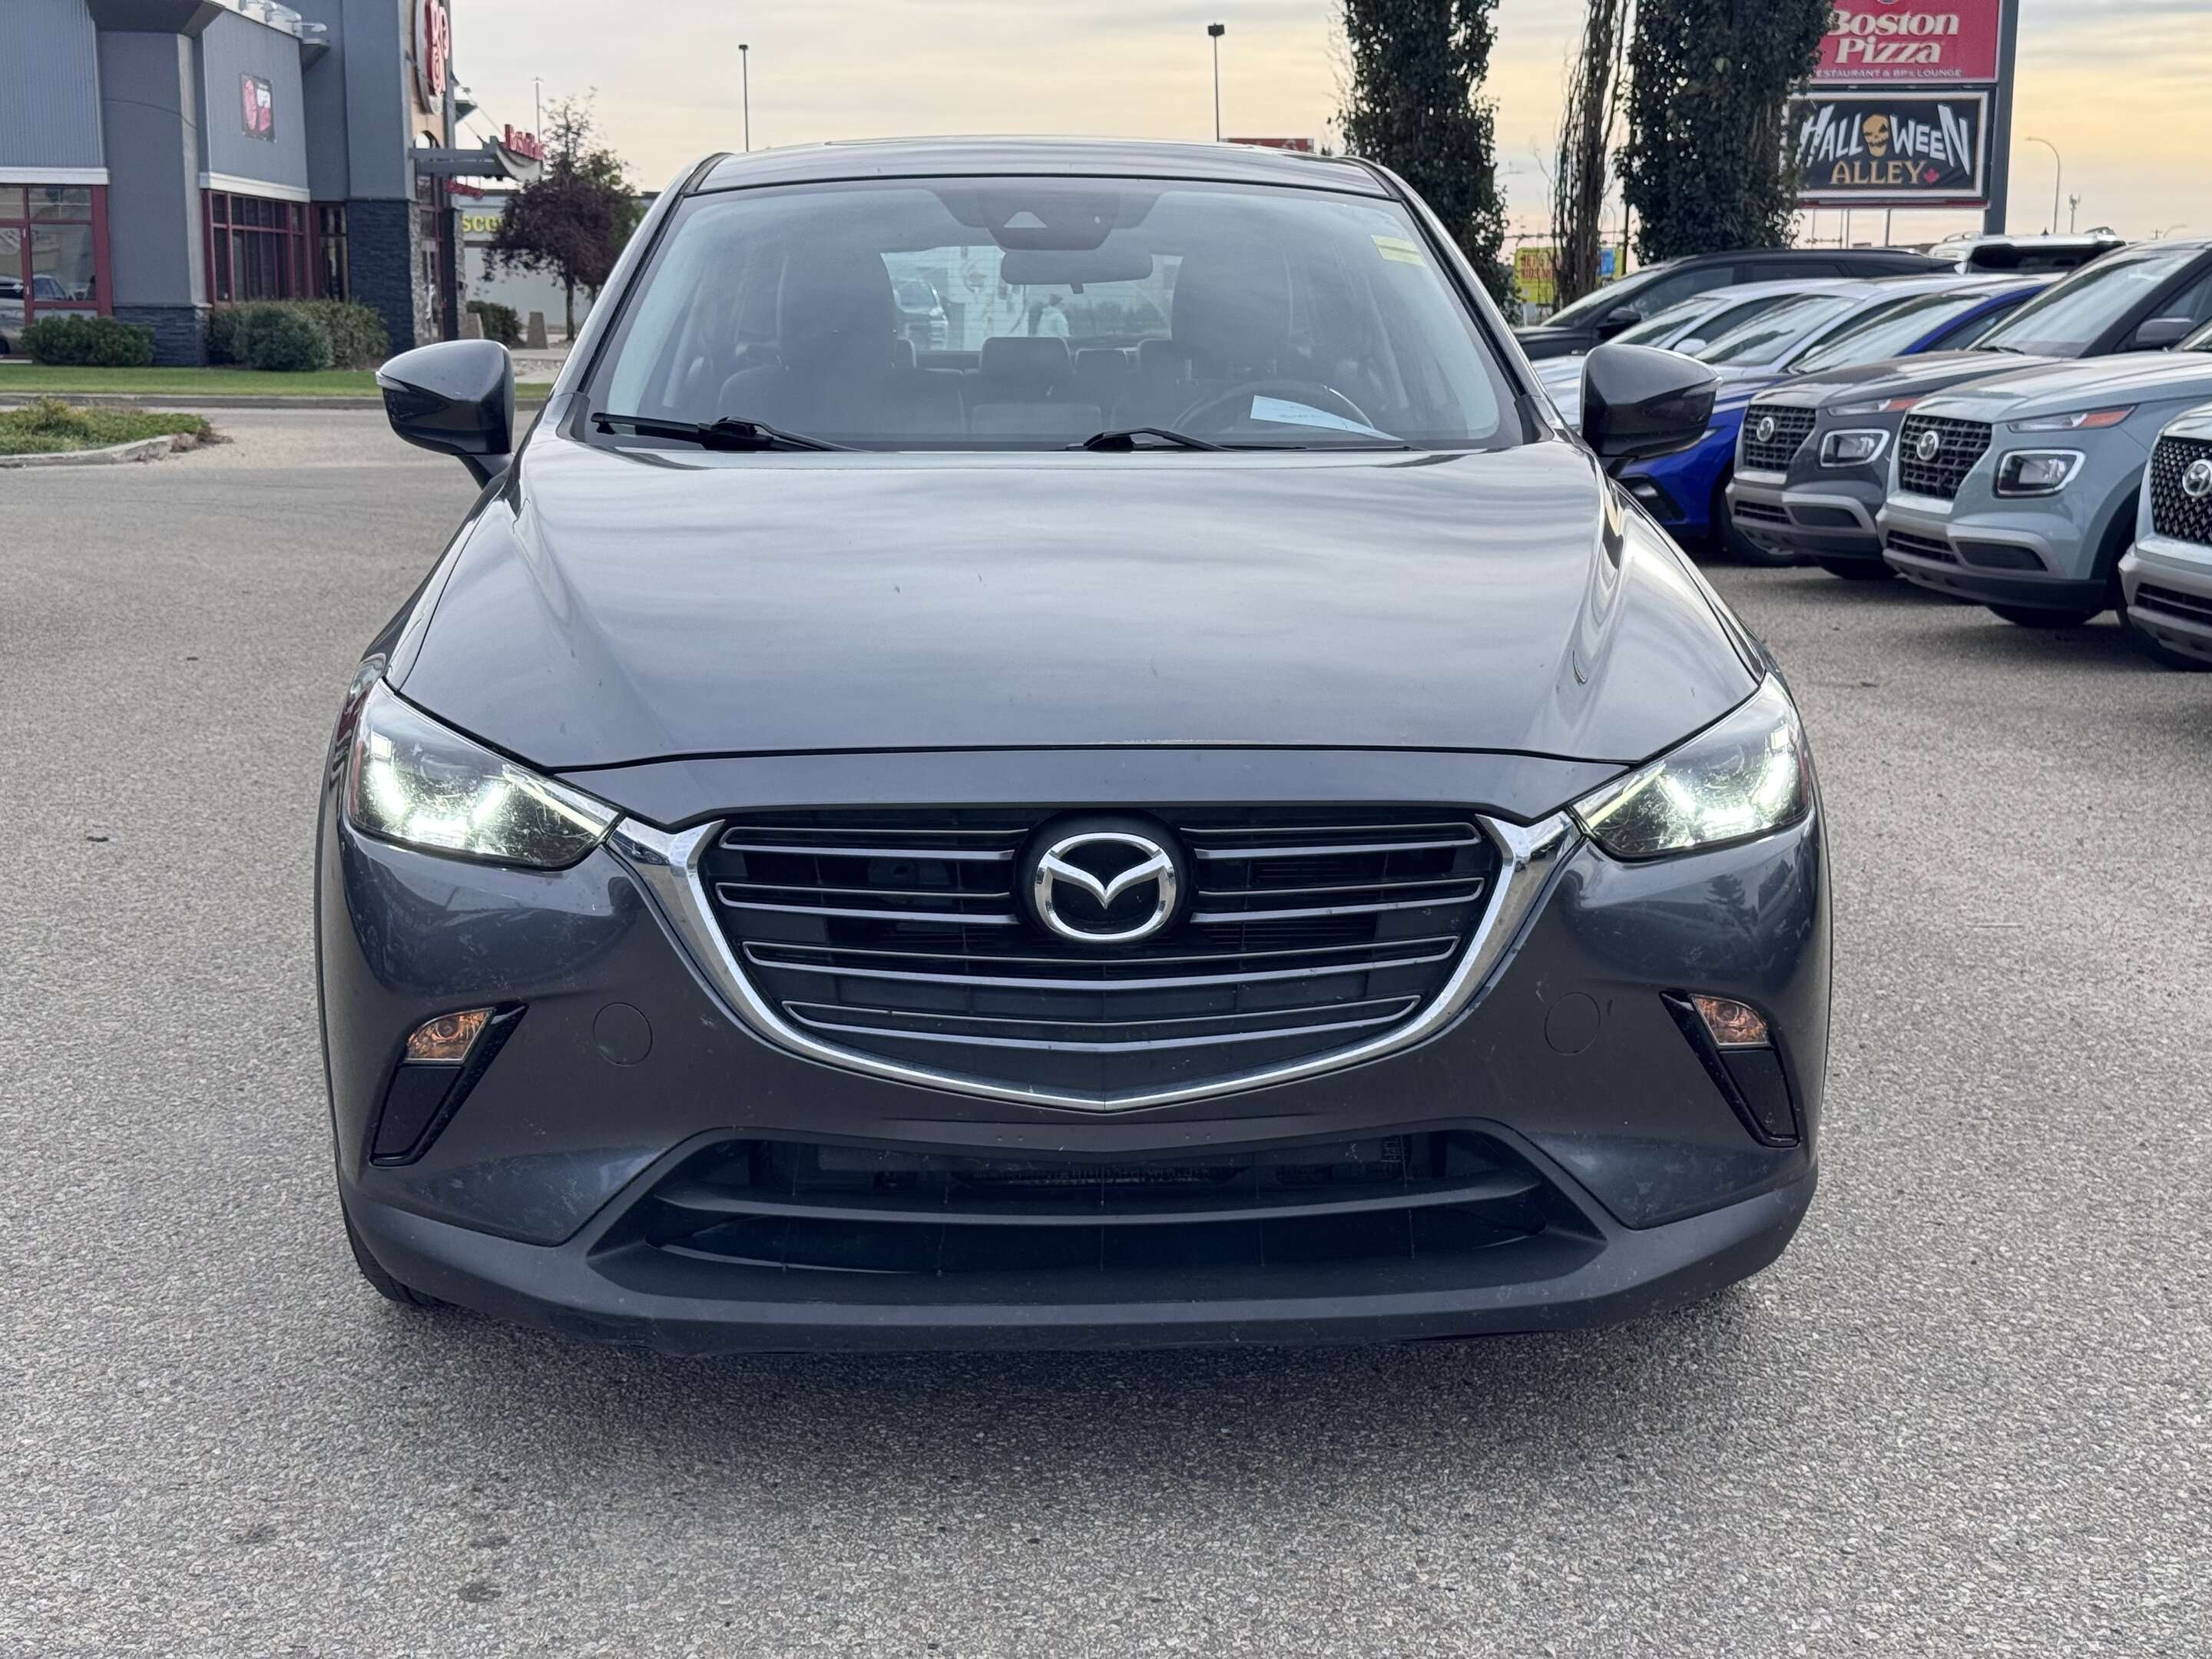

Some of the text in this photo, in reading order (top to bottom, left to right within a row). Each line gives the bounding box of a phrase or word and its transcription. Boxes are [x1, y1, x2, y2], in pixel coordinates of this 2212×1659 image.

[1827, 10, 1959, 35] Boston
[1834, 37, 1942, 64] Pizza
[1813, 68, 1880, 78] ESTAURANT
[1916, 69, 1962, 78] LOUNGE
[1830, 160, 1927, 184] ALLEY
